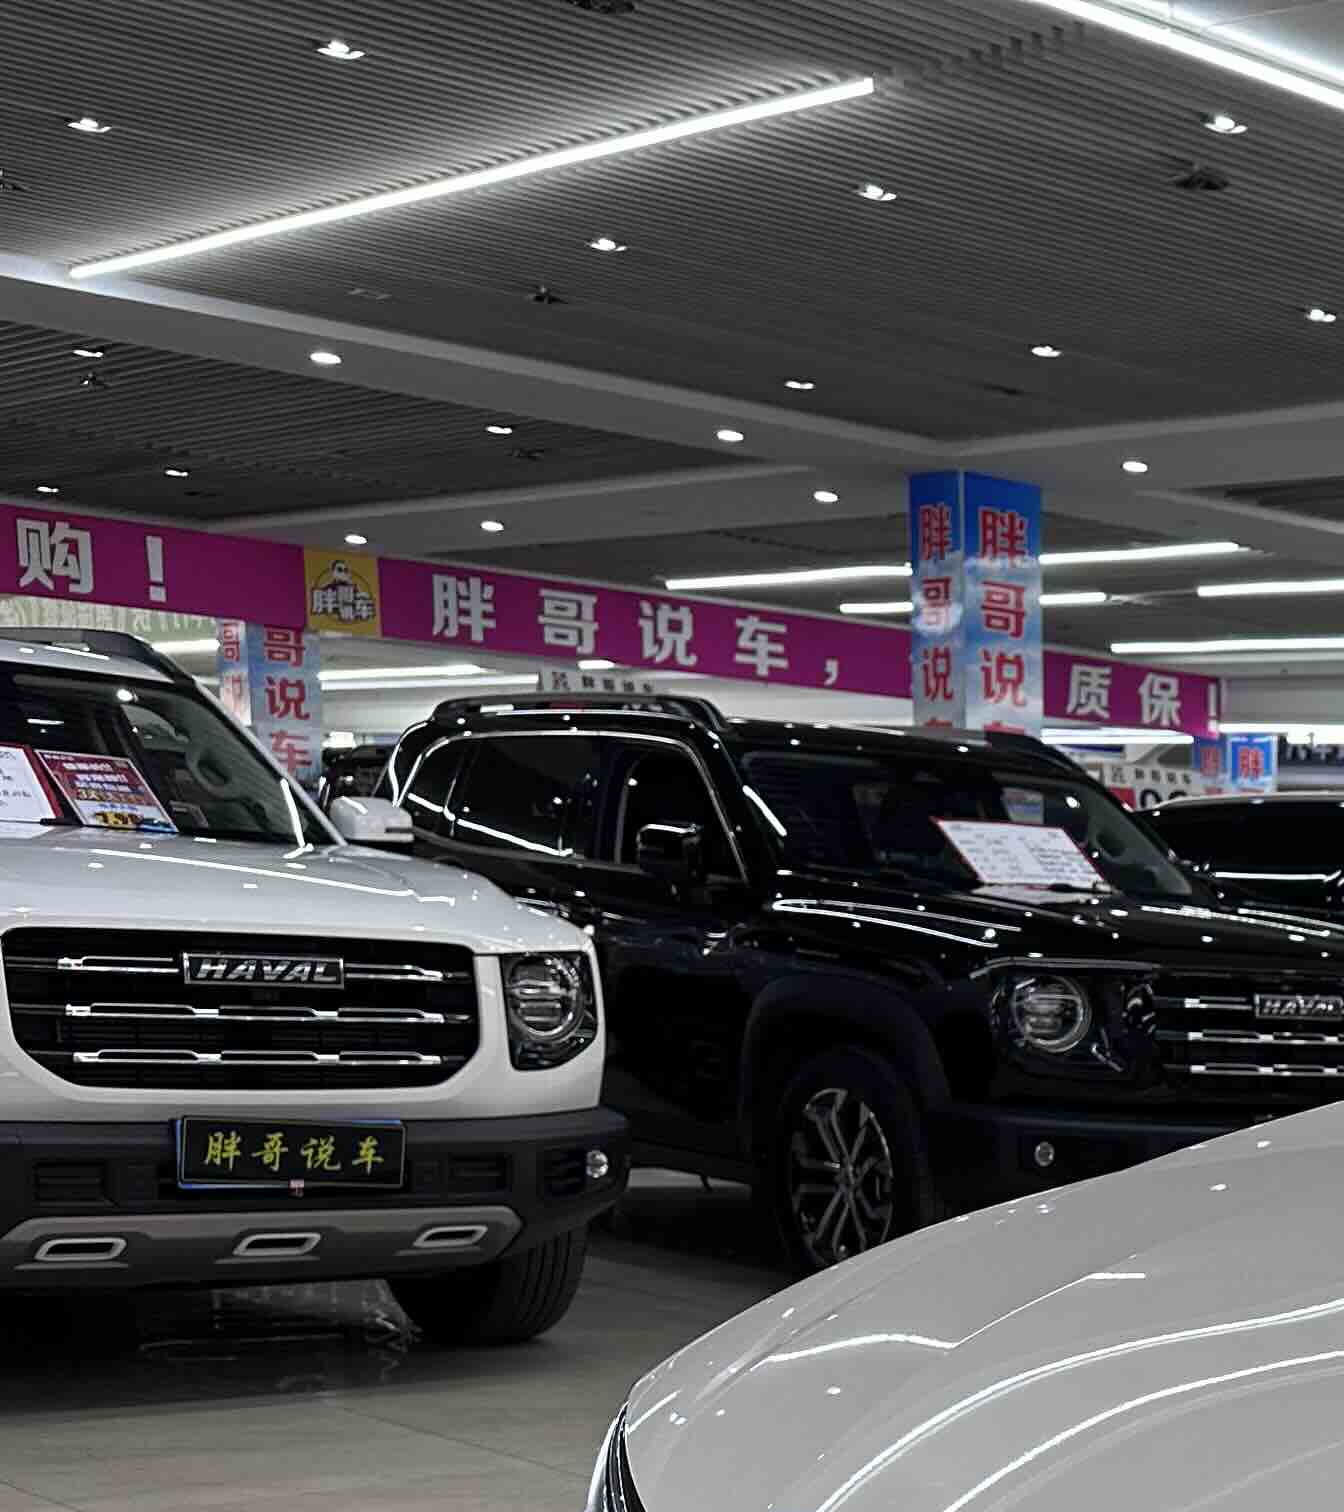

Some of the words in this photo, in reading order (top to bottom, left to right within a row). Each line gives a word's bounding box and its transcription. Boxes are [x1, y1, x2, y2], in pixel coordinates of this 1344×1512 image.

[919, 503, 953, 729] 胖哥说
[978, 508, 1028, 735] 胖哥说
[197, 959, 336, 982] HAVAL
[205, 1131, 385, 1175] 胖哥说车
